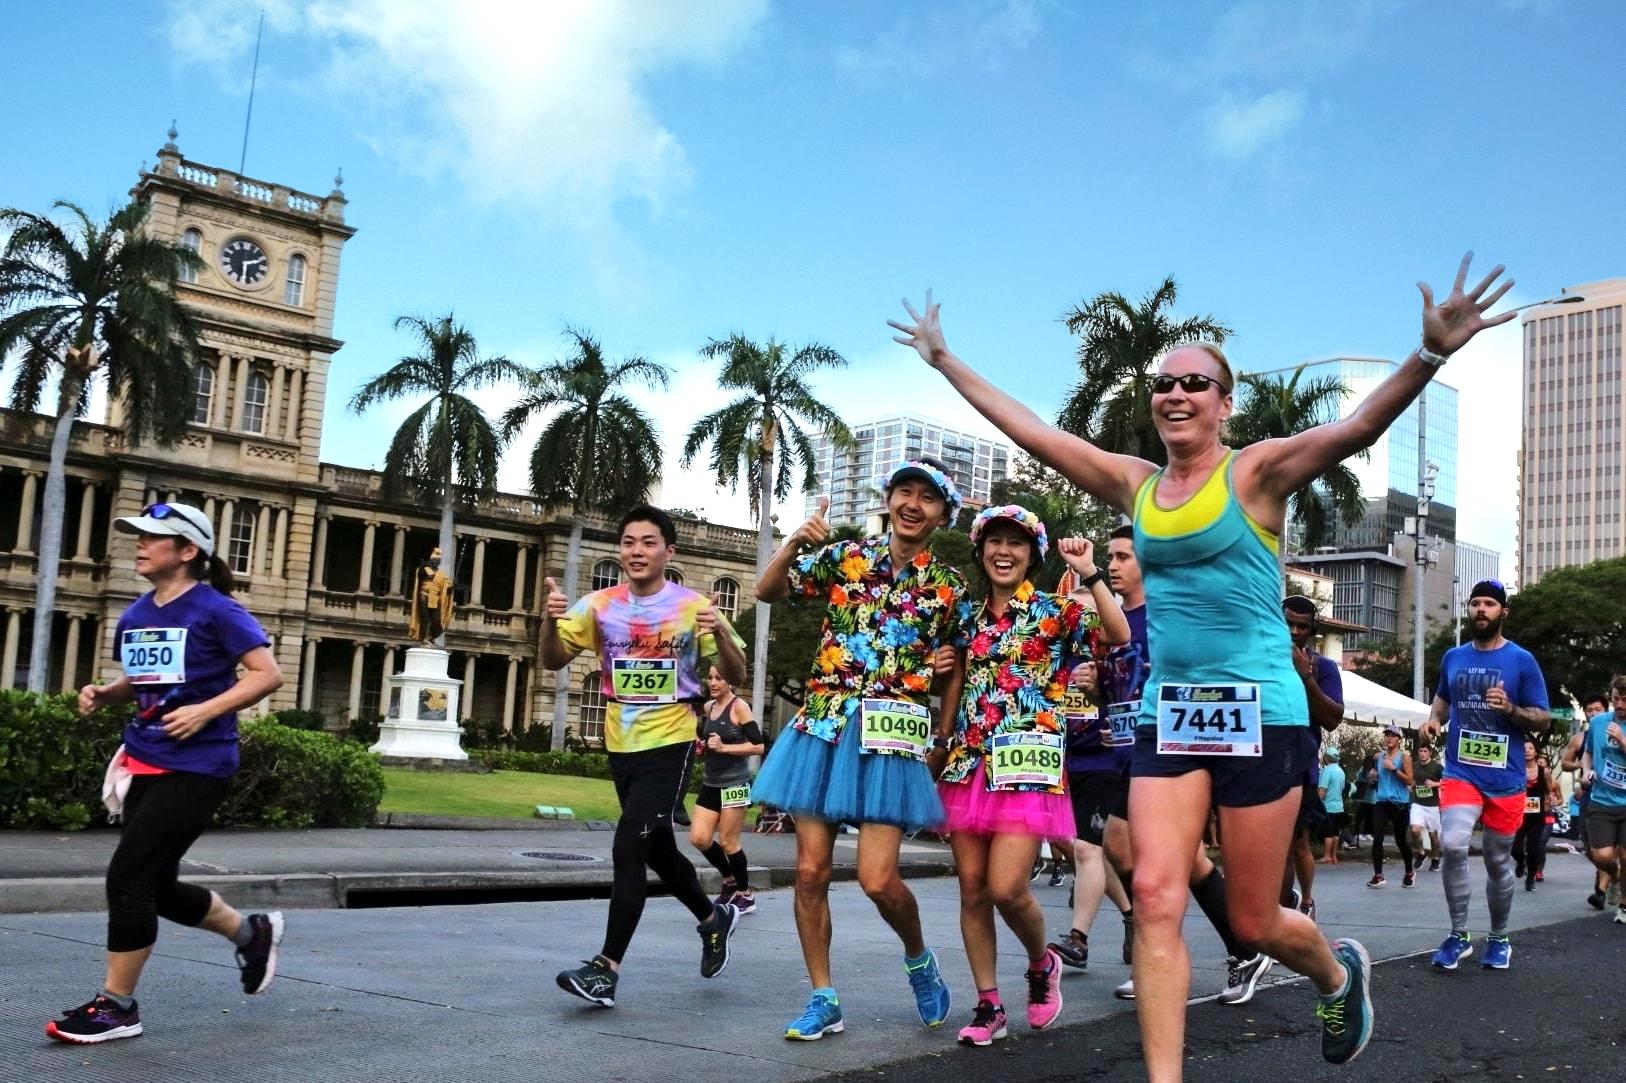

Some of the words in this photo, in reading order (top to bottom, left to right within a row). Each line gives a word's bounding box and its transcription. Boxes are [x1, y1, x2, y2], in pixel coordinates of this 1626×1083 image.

[128, 647, 172, 667] 2050
[621, 673, 668, 689] 7367
[1457, 701, 1489, 710] ENDURAN
[867, 715, 928, 739] 10490
[1170, 708, 1247, 732] 7441
[997, 749, 1060, 769] 10489
[1464, 742, 1501, 757] 1234
